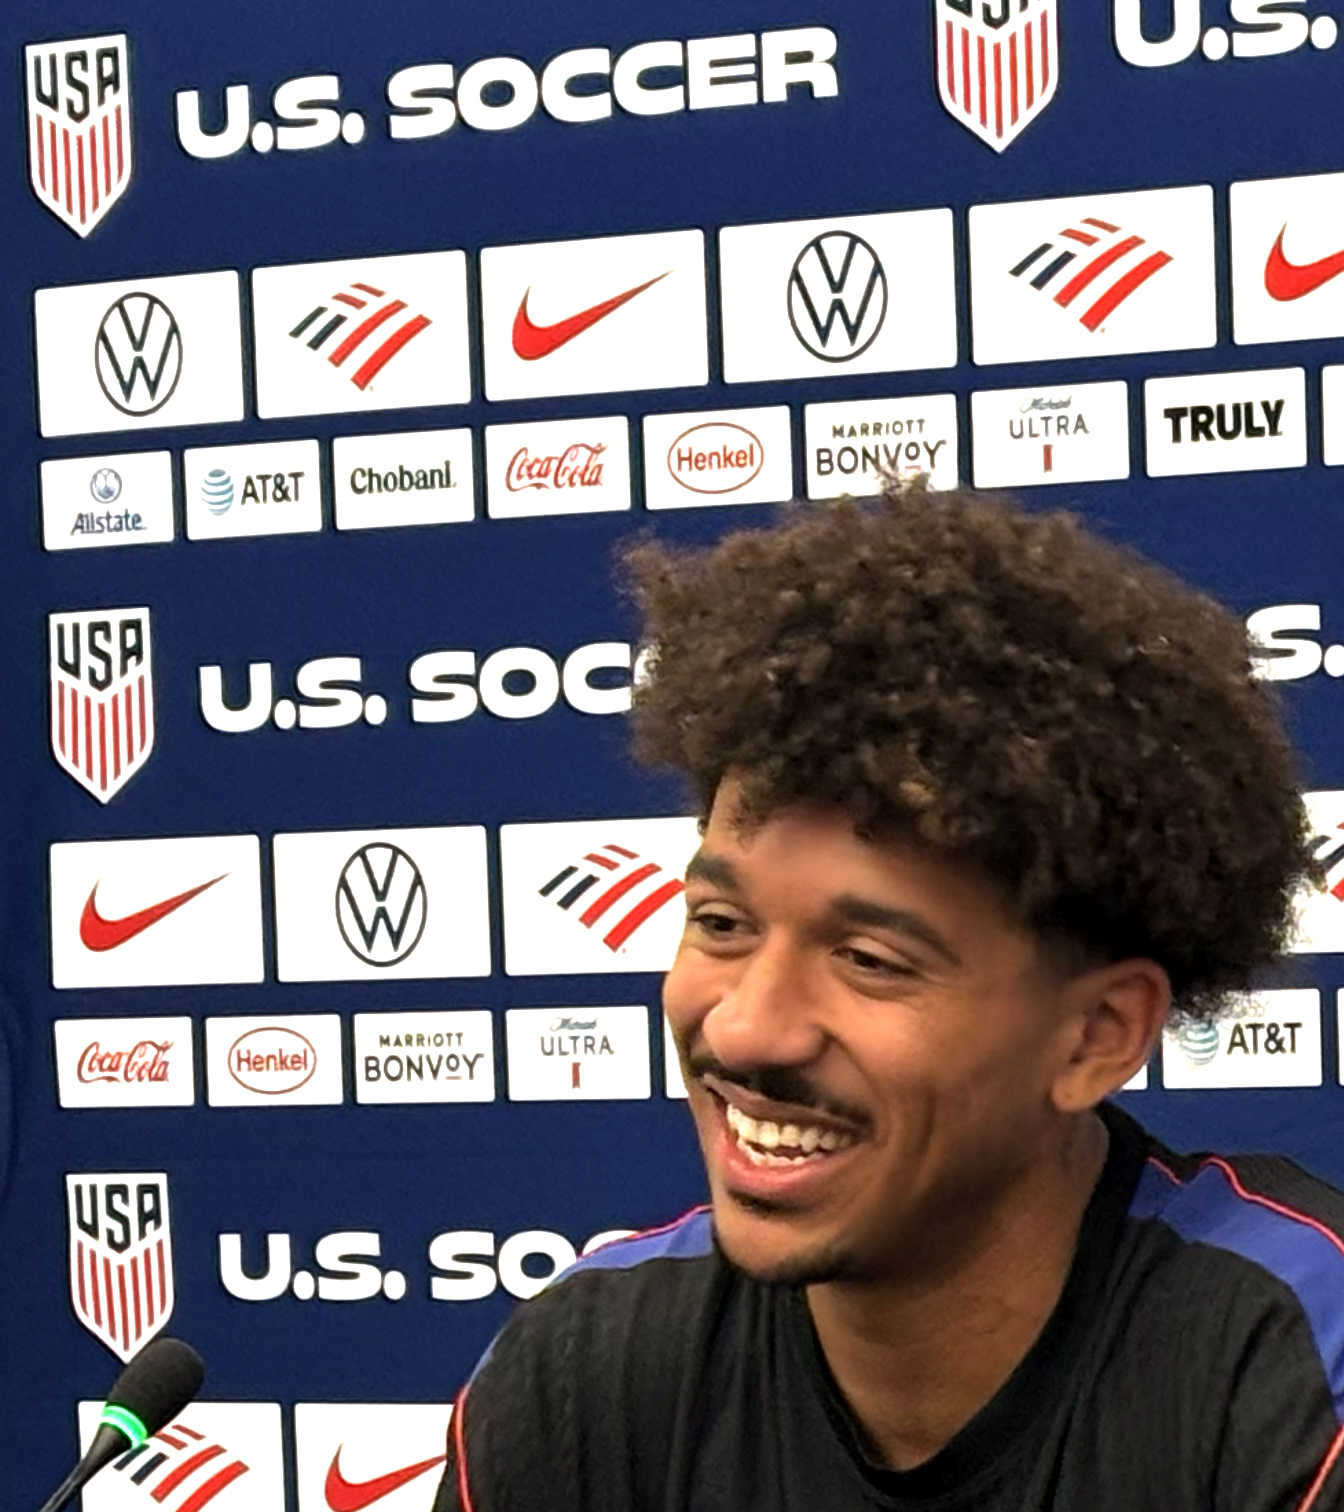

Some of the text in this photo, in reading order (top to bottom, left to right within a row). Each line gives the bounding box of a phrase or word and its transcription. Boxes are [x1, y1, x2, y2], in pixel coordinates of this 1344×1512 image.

[35, 47, 119, 122] USA
[177, 28, 838, 158] U.S. SOCCER
[832, 419, 925, 438] MARRIOTT
[1010, 414, 1089, 439] ULTRA
[1163, 399, 1285, 443] TRULY
[677, 443, 754, 471] Henkel
[241, 472, 304, 505] AT&T
[57, 619, 143, 691] USA
[200, 658, 386, 732] U.S.
[379, 1033, 463, 1047] MARRIOTT
[541, 1036, 614, 1056] ULTRA
[1227, 1022, 1302, 1055] AT&T
[237, 1049, 307, 1072] Henkel
[75, 1184, 161, 1253] USA
[220, 1232, 406, 1300] U.S.
